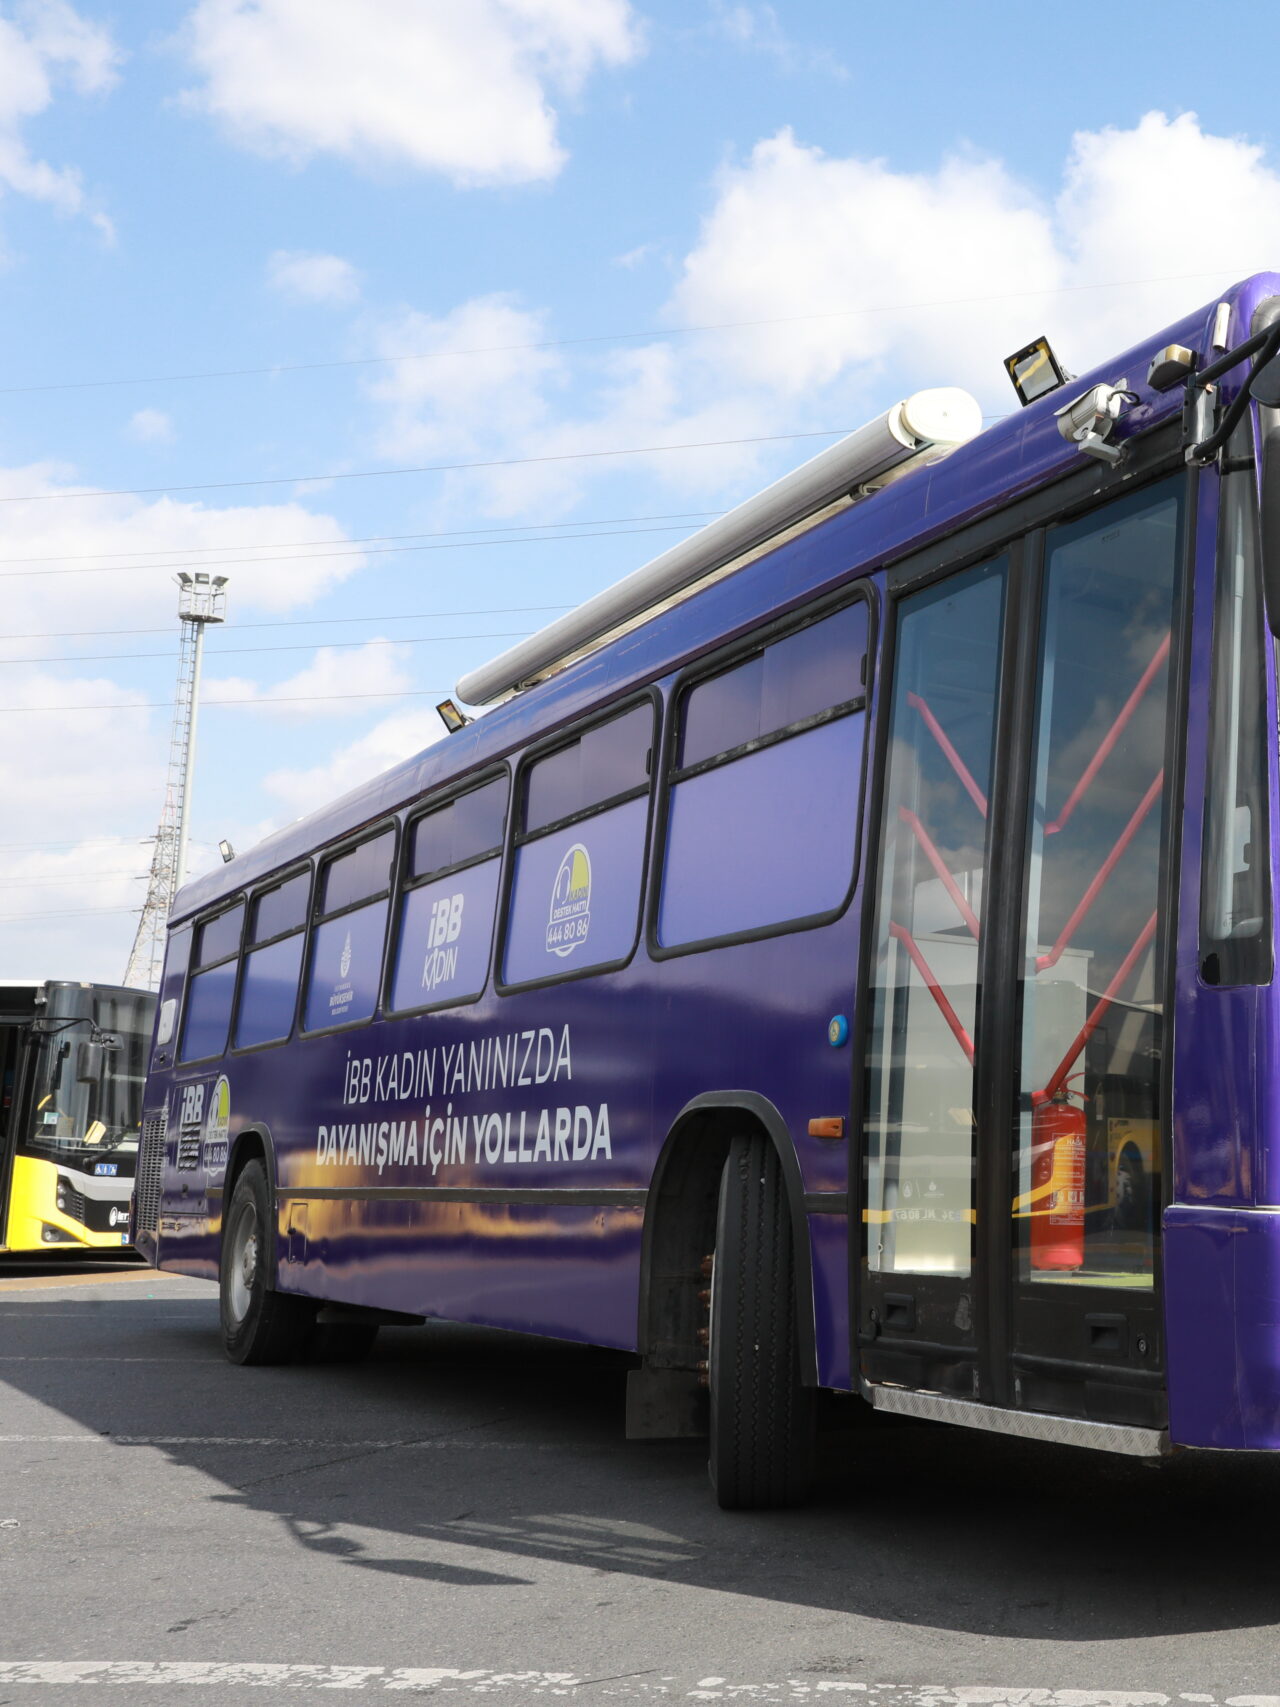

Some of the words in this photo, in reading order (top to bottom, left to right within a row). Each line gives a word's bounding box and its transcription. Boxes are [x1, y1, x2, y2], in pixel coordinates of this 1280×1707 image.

[548, 925, 562, 944] 444
[563, 921, 576, 940] 80
[576, 918, 588, 938] 86
[422, 946, 458, 992] KADIN
[343, 1050, 372, 1104] İBB
[374, 1048, 436, 1102] KADIN
[442, 1024, 572, 1095] YANINIZDA
[316, 1120, 419, 1176] DAYANIŞMA
[422, 1102, 468, 1176] İÇİN
[472, 1103, 613, 1165] YOLLARDA
